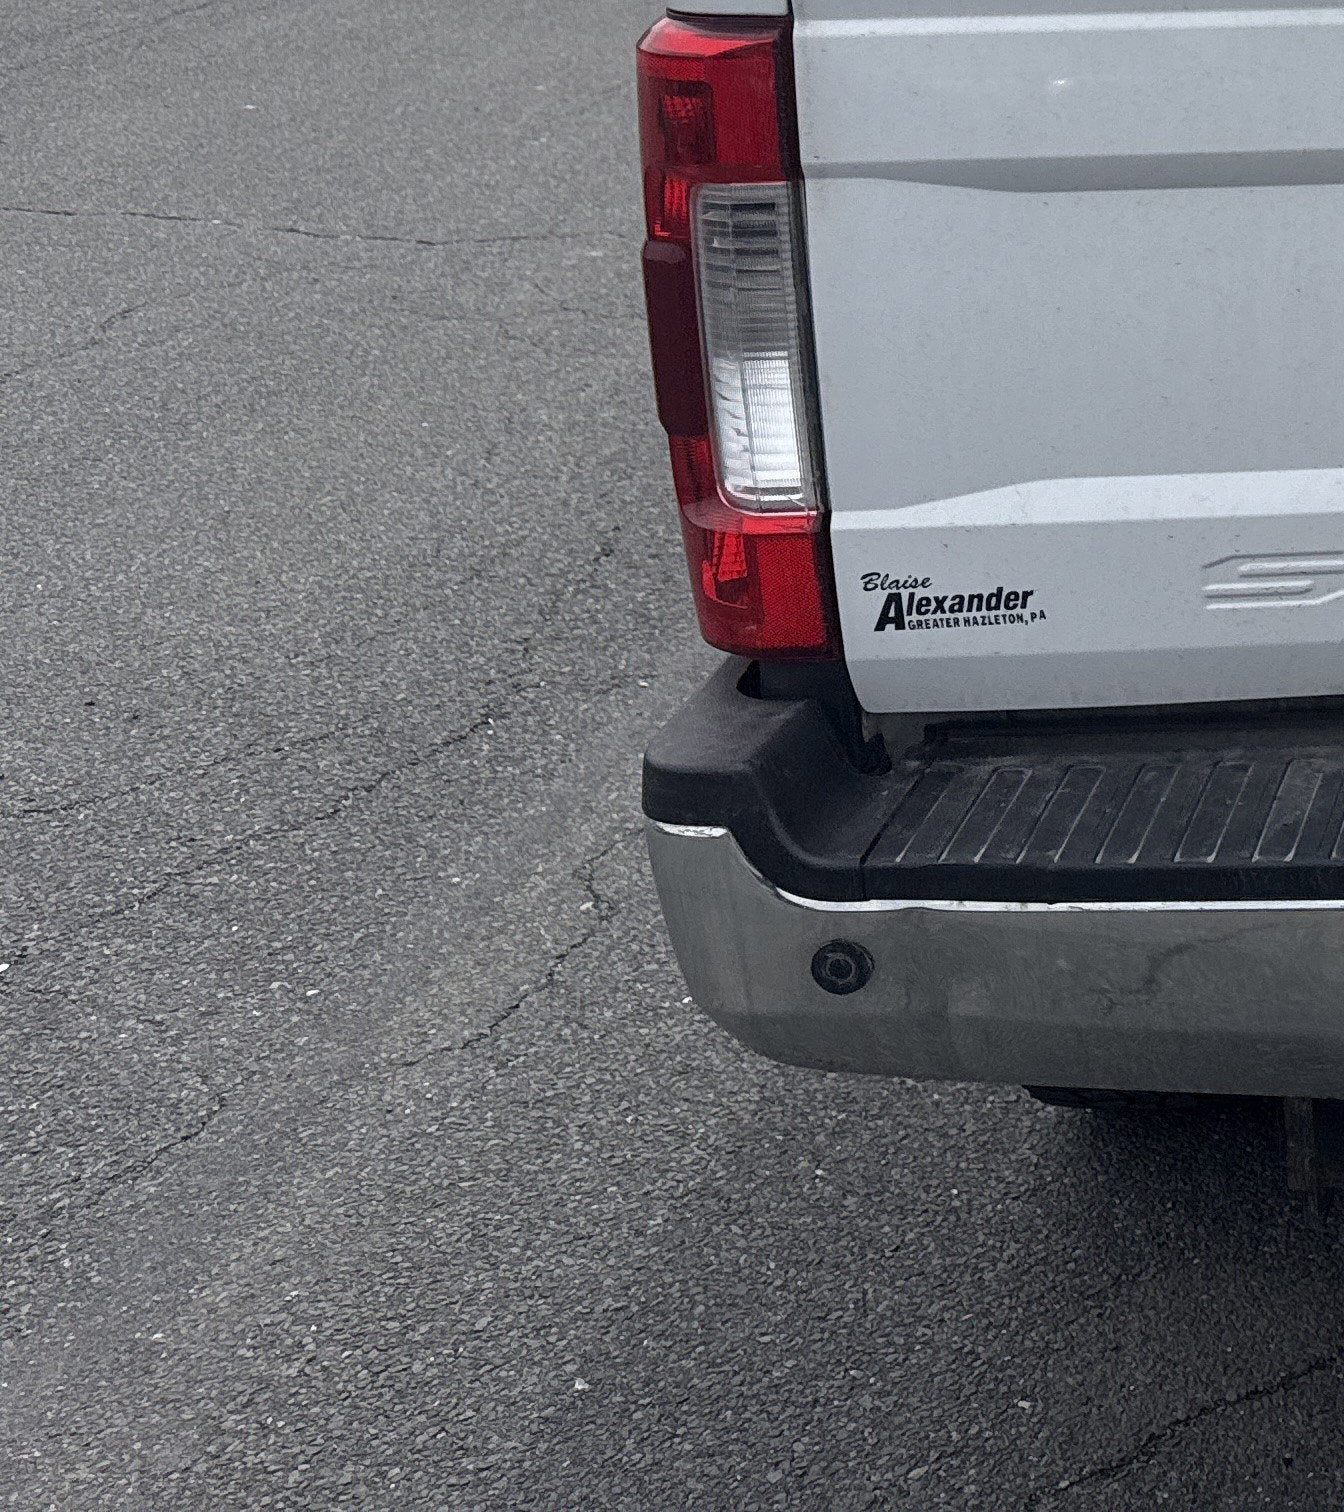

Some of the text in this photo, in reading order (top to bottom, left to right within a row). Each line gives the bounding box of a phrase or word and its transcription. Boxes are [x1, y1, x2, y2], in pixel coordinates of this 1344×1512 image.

[860, 572, 933, 592] Blaise
[874, 586, 1034, 632] Alexander
[907, 610, 1047, 630] GREATER HAZLETON, PA
